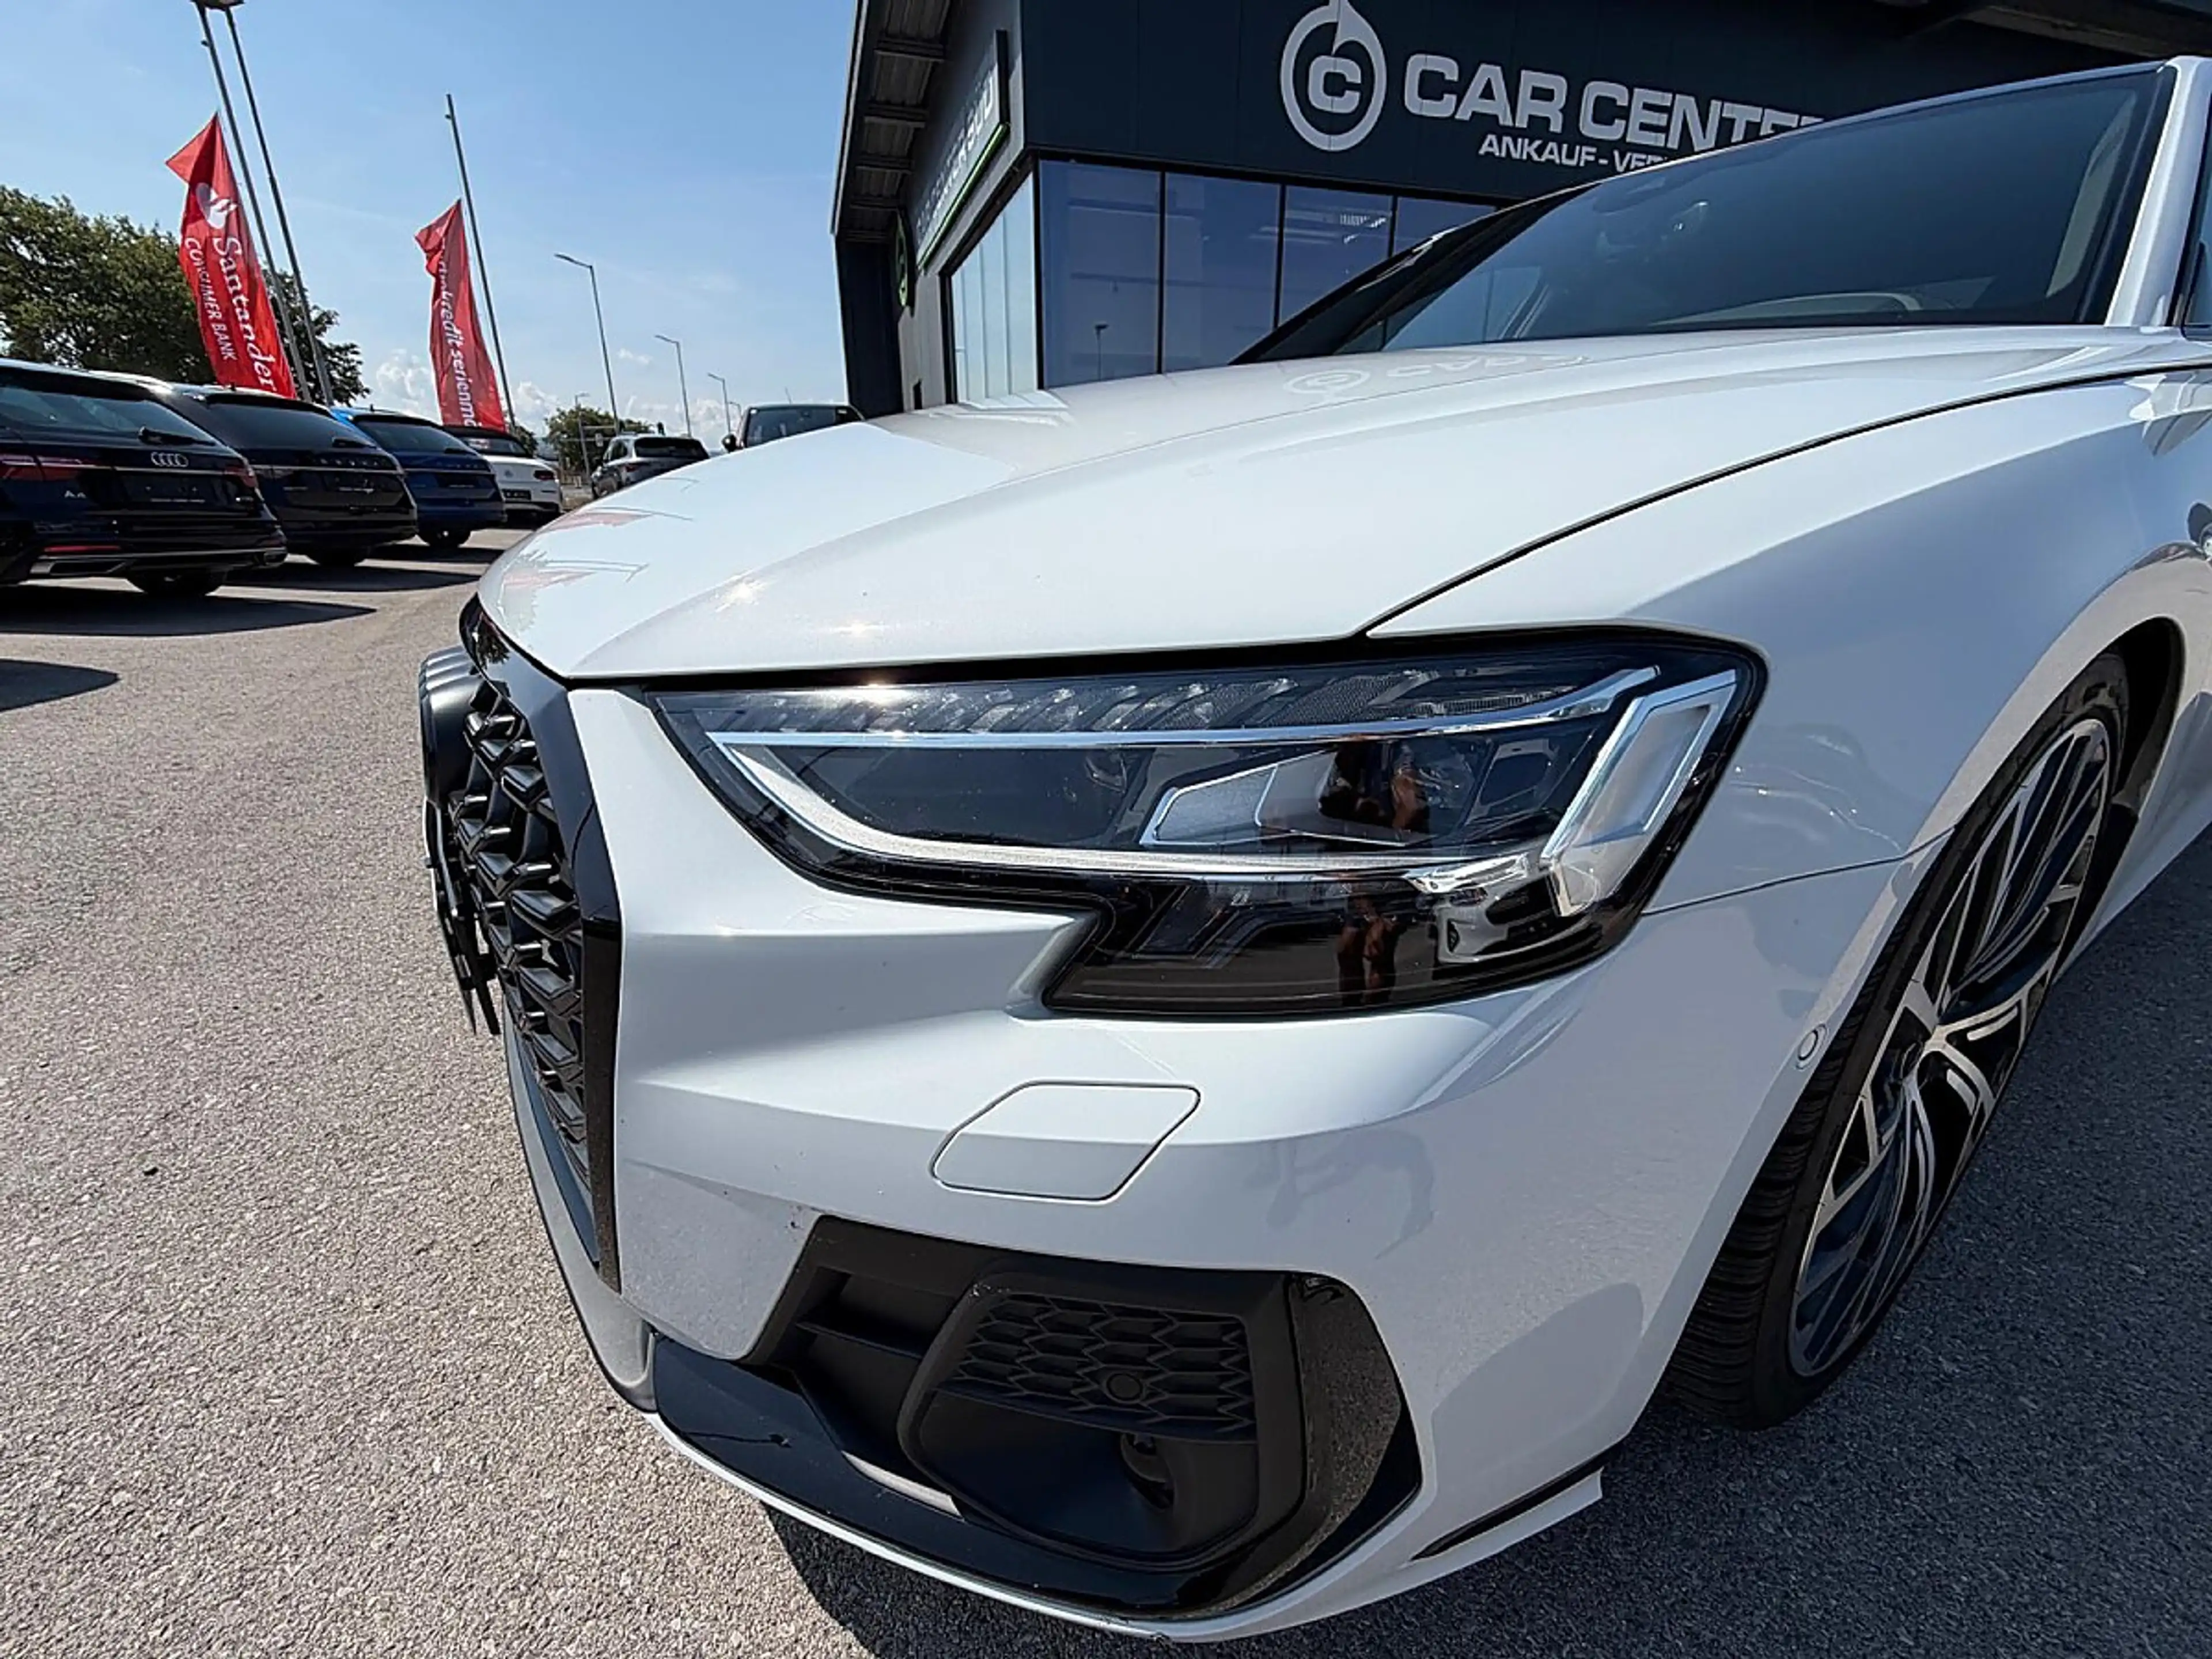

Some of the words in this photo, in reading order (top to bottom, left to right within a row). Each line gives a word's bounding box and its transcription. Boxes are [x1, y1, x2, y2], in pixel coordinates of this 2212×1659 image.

[1404, 53, 1568, 134] CAR
[1579, 80, 1824, 152] CENT
[211, 322, 238, 361] BANK
[212, 237, 278, 392] Santander
